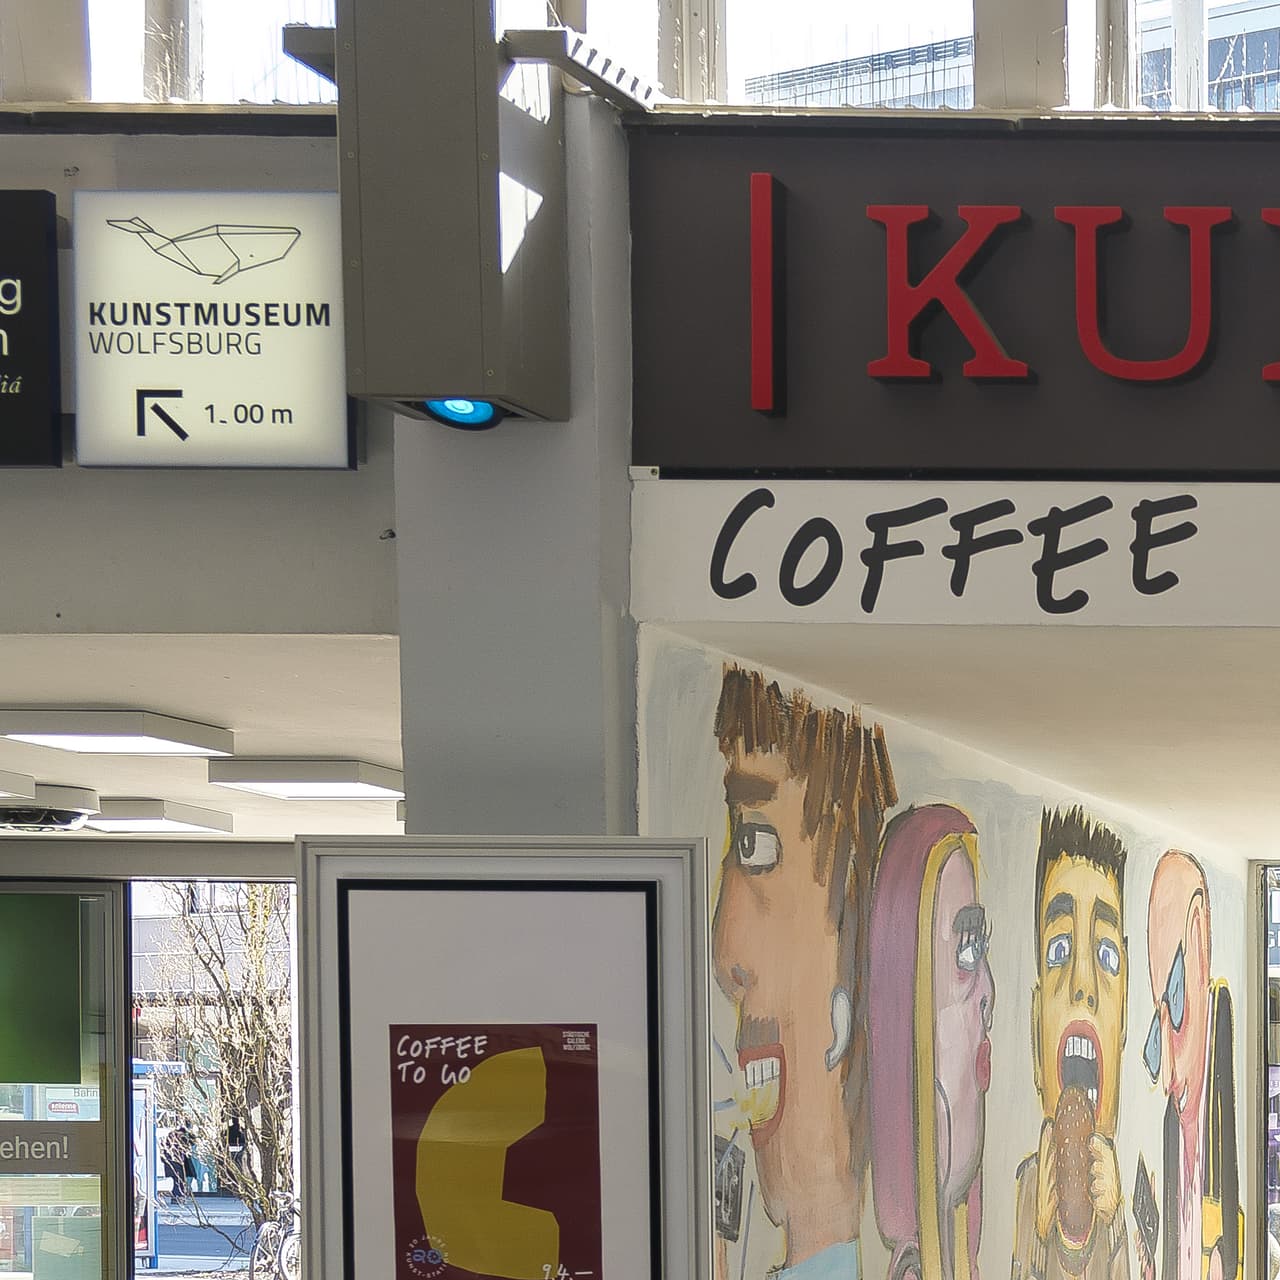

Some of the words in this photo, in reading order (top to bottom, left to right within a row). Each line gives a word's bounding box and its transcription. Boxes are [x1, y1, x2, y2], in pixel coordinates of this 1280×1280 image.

[88, 302, 331, 327] KUNSTMUSEUM
[88, 331, 263, 355] WOLFSBURG
[271, 407, 293, 424] m
[708, 488, 1199, 615] COFFEE
[396, 1034, 489, 1059] COFFEE
[397, 1060, 427, 1084] TO
[440, 1063, 472, 1085] GO
